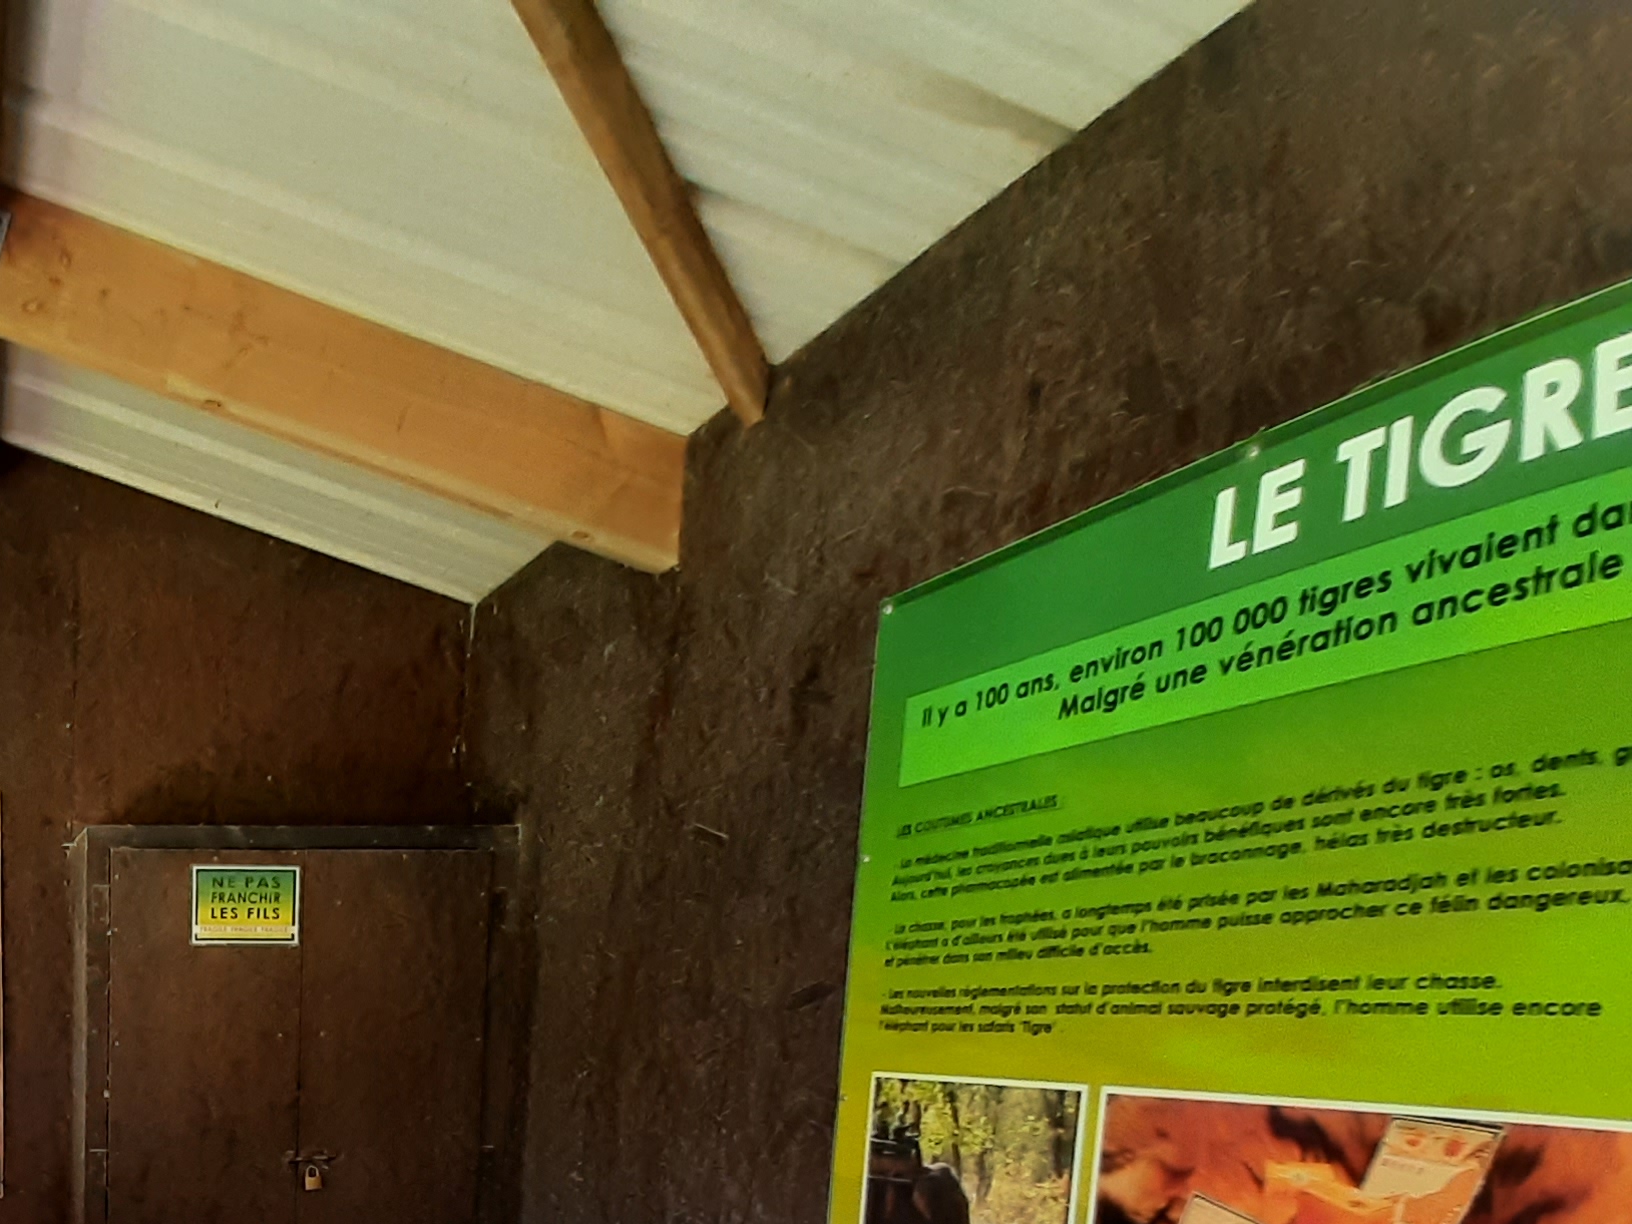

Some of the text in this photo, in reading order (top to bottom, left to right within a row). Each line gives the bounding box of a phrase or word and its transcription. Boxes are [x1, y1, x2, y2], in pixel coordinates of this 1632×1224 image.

[1209, 330, 1632, 570] LE TIGRE
[921, 502, 1632, 728] Il y a 100 ans, environ 100 000 tigres vivaient da
[1058, 550, 1624, 720] Malgré une vénération ancestrale
[1175, 801, 1264, 826] beaucoup
[1271, 795, 1296, 811] de
[1302, 779, 1376, 807] dérivés
[1382, 777, 1410, 794] du
[1417, 769, 1468, 791] tigre
[1204, 818, 1305, 843] bénéfiques
[1312, 808, 1354, 828] sont
[1359, 800, 1436, 822] encore
[1445, 791, 1486, 811] très
[1138, 858, 1166, 875] par
[1171, 854, 1185, 869] le
[1315, 831, 1369, 851] hélas
[1375, 824, 1414, 845] très
[1422, 810, 1563, 839] destructeur.
[211, 892, 281, 904] FRANCHIR
[212, 876, 281, 889] NE PAS
[1188, 890, 1241, 912] prisée
[1245, 889, 1279, 906] par
[1283, 885, 1310, 900] les
[1456, 867, 1480, 887] et
[1485, 865, 1519, 884] les
[211, 907, 280, 920] LES FILS
[1071, 925, 1105, 941] pour
[1108, 923, 1137, 938] que
[1218, 912, 1275, 931] puisse
[1279, 902, 1389, 926] approcher
[1395, 901, 1424, 917] ce
[1430, 894, 1480, 913] félin
[1185, 979, 1207, 994] du
[1212, 977, 1252, 996] tigre
[1366, 972, 1410, 991] leur
[1416, 972, 1503, 990] chasse.
[1167, 1002, 1241, 1019] sauvage
[1513, 1000, 1603, 1016] encore
